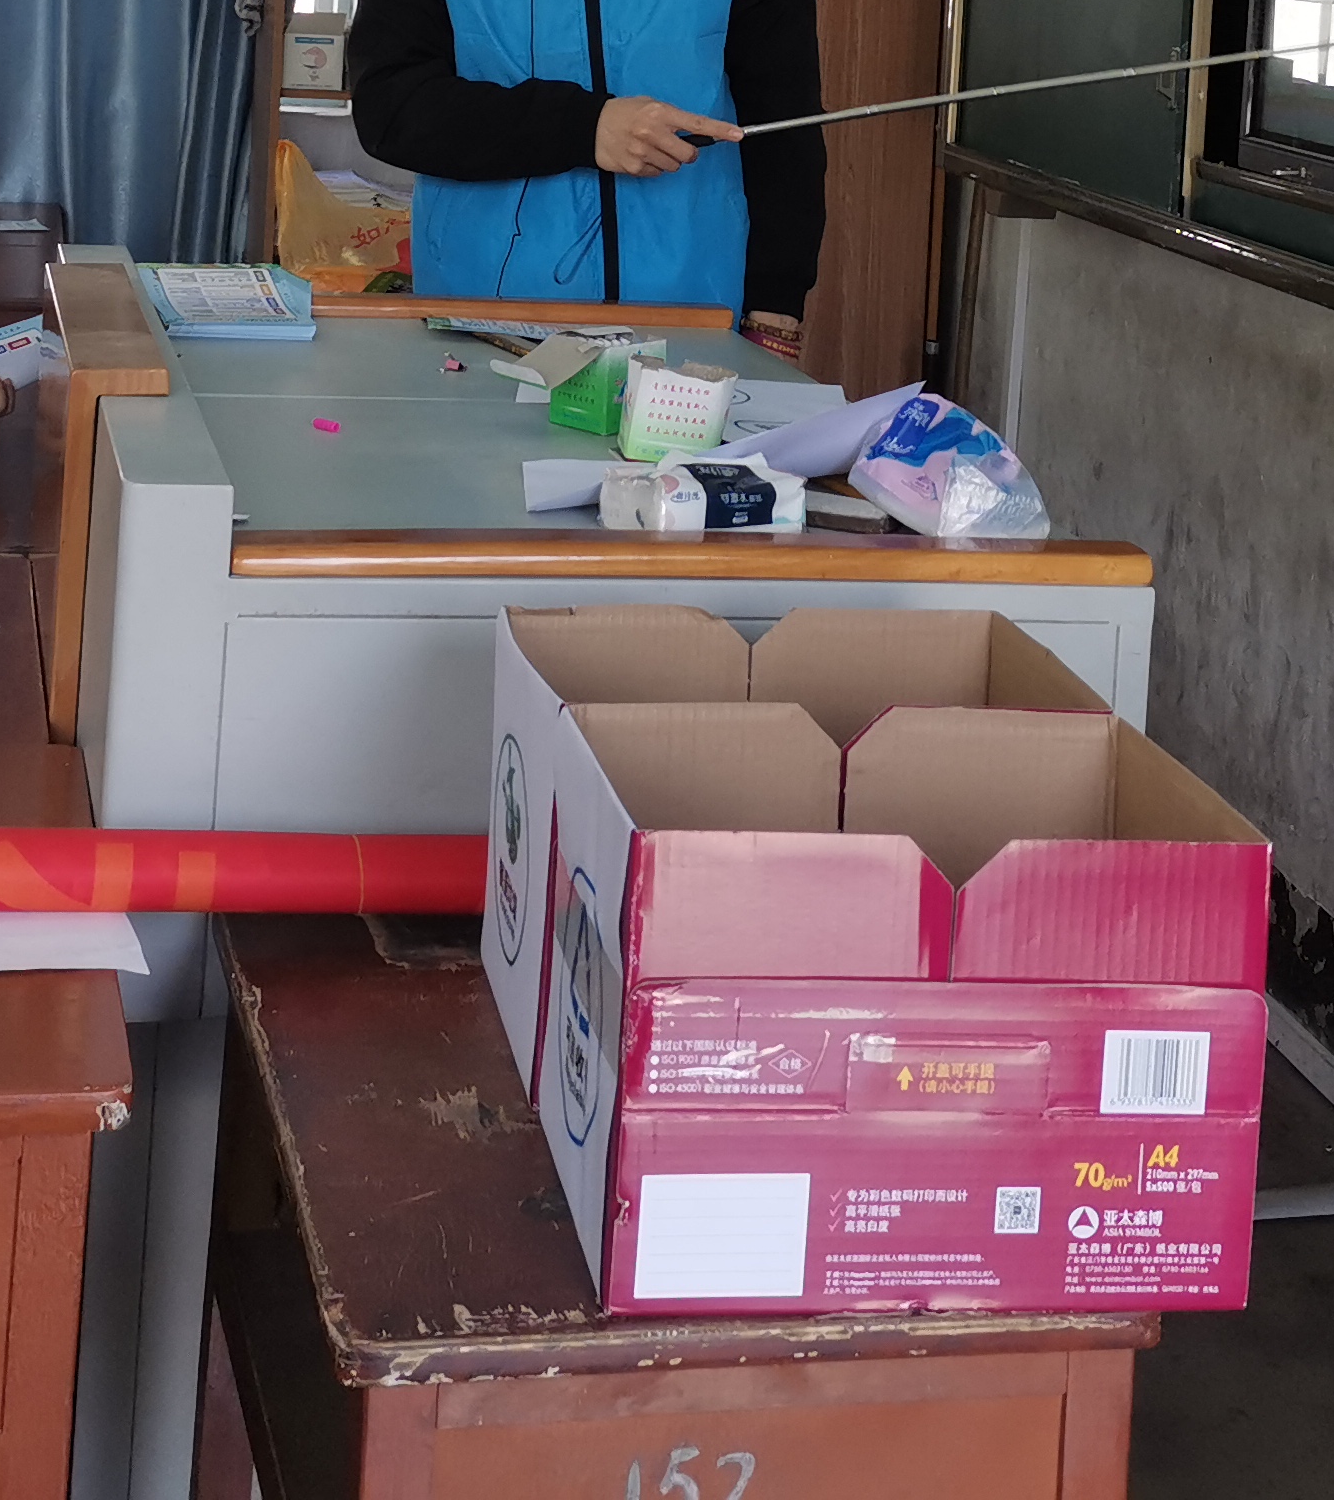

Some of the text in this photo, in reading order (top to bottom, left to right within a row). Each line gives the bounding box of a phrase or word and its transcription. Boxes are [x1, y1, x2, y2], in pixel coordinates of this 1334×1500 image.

[779, 1057, 803, 1071] 合格
[1146, 1143, 1180, 1167] A4
[1103, 1210, 1164, 1227] 亚太森博
[1102, 1227, 1162, 1237] ASIA SYMBOL
